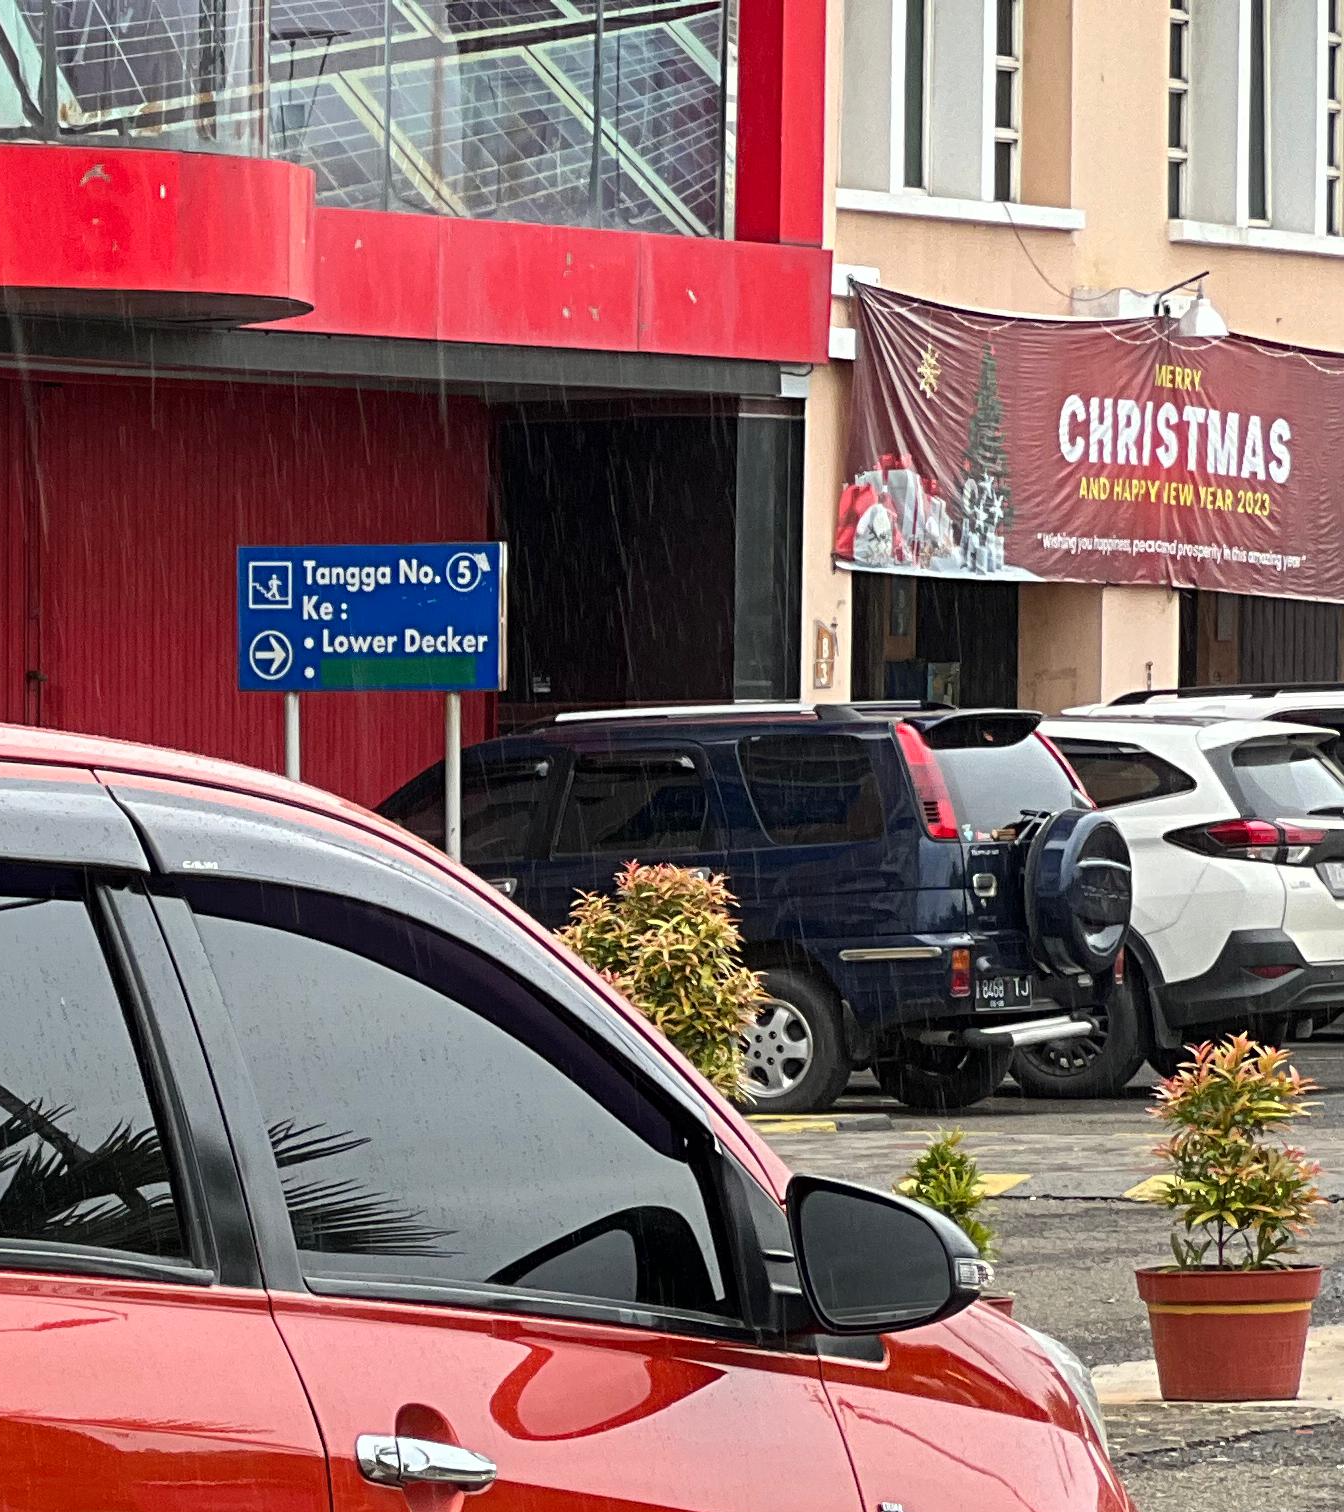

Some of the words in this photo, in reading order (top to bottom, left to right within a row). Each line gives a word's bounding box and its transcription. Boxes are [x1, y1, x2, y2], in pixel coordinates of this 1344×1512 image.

[1155, 363, 1202, 392] MERRY
[1058, 394, 1292, 484] CHRISTMAS
[1079, 477, 1110, 501] AND
[1113, 478, 1161, 503] HAPPY
[1198, 486, 1234, 512] YEAR
[1237, 490, 1271, 516] 2023
[303, 560, 391, 592] Tangga
[399, 559, 441, 584] No.
[302, 596, 334, 620] Ke
[322, 629, 397, 653] Lower
[404, 627, 488, 653] Decker
